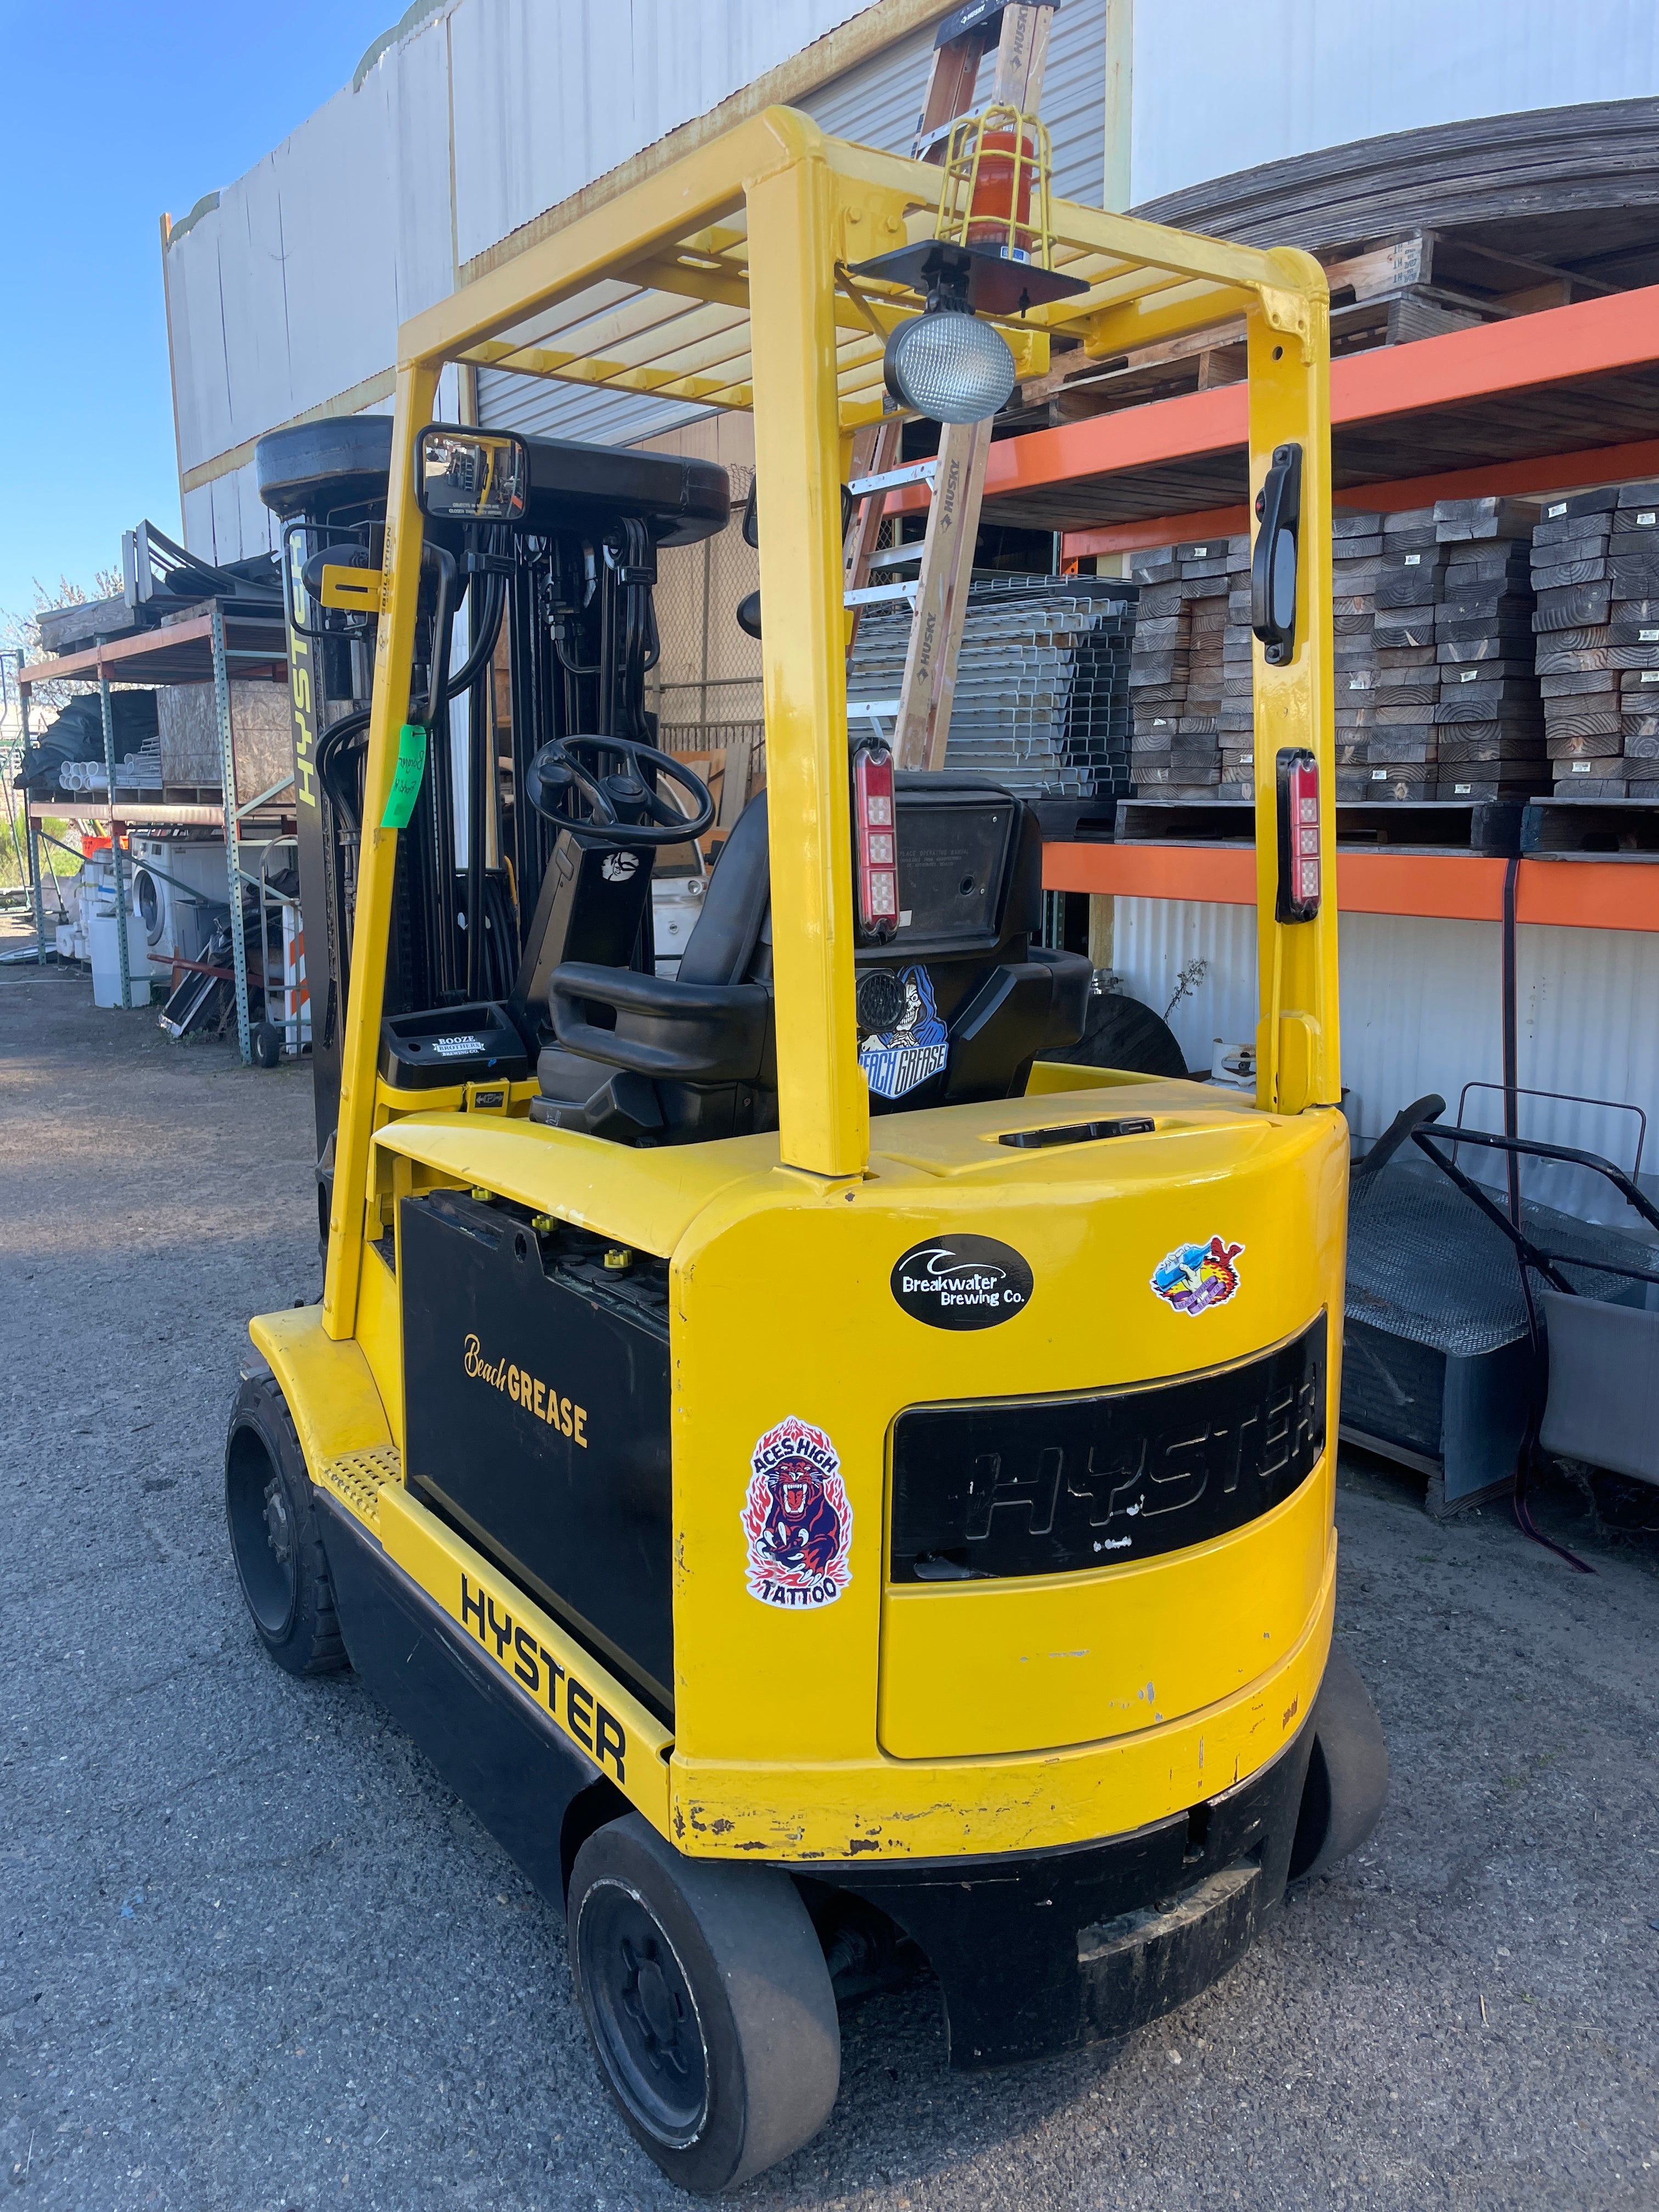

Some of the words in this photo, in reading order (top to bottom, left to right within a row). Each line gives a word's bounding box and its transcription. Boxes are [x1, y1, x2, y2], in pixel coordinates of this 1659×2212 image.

[966, 4, 986, 21] HUSKY
[943, 459, 960, 513] HUSKY
[921, 613, 937, 667] HUSKY
[438, 1035, 476, 1045] BOOZE
[439, 1042, 480, 1051] BROTHERS
[859, 1051, 899, 1095] EACH
[894, 1045, 945, 1095] GREASE
[902, 1274, 997, 1293] Breakwater
[941, 1289, 1000, 1307] Brewing
[1003, 1289, 1025, 1302] Co.
[1177, 1295, 1195, 1308] BEACH
[1194, 1278, 1212, 1298] GREASE
[1198, 1294, 1212, 1310] BEER
[464, 1333, 506, 1392] Beach
[507, 1364, 588, 1448] GREASE
[754, 1437, 794, 1474] ACES
[797, 1437, 838, 1474] HIGH
[965, 1362, 1316, 1541] HYSTER
[761, 1577, 837, 1606] TATTOO
[461, 1572, 625, 1785] HYSTER
